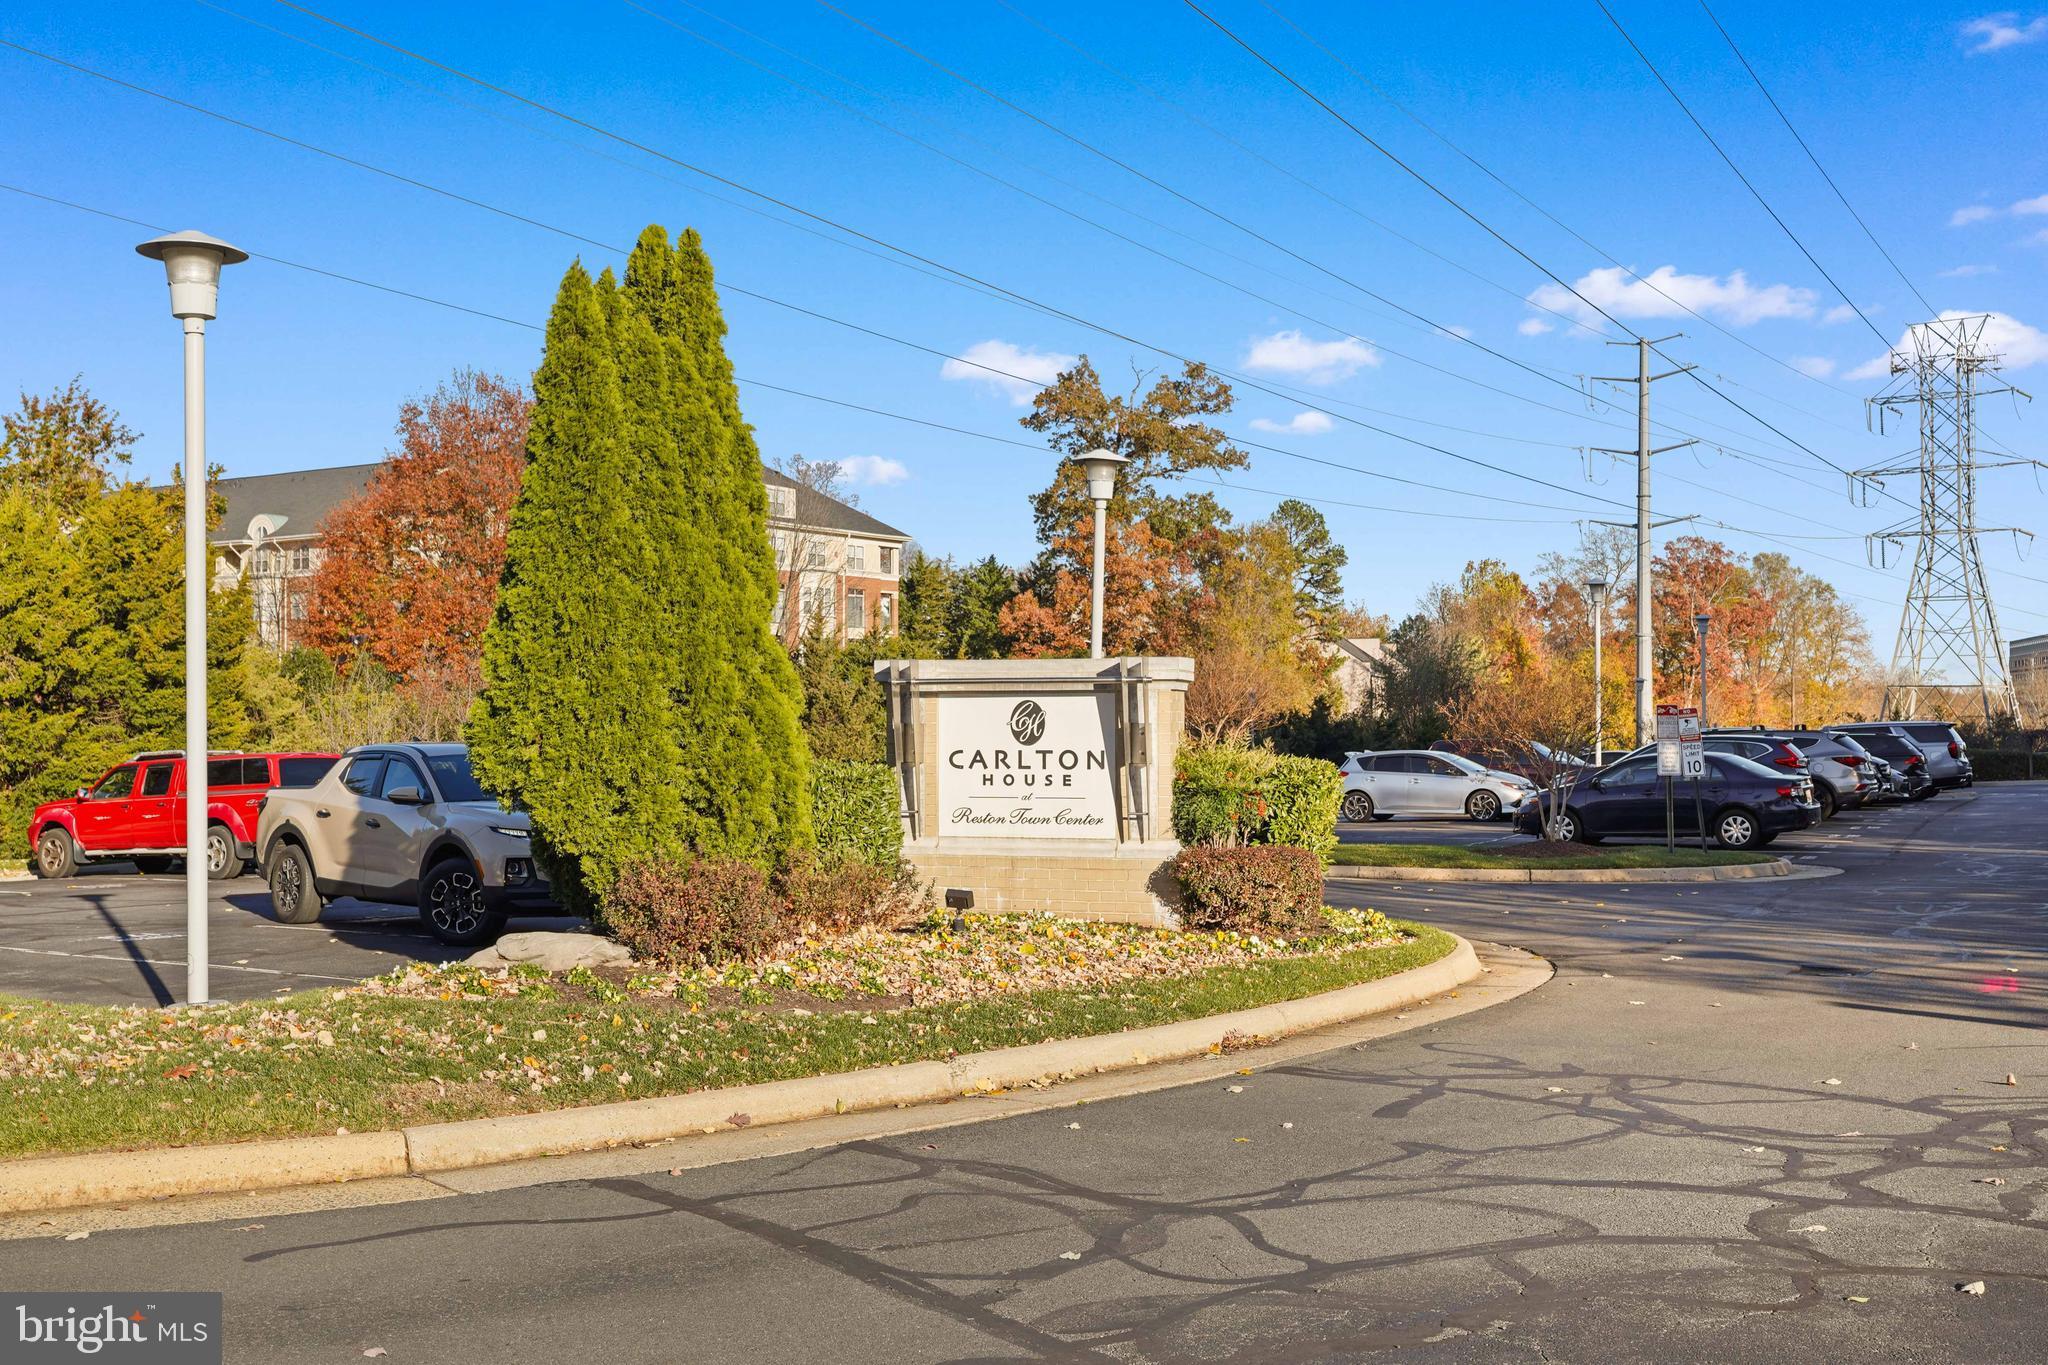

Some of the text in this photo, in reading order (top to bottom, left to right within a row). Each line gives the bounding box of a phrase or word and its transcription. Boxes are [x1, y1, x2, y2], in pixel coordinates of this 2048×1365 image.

[949, 750, 1105, 770] CARLTON
[1687, 760, 1702, 773] 10
[982, 774, 1072, 787] HOUSE
[1021, 792, 1033, 801] at
[951, 807, 1104, 826] Reston Town Center
